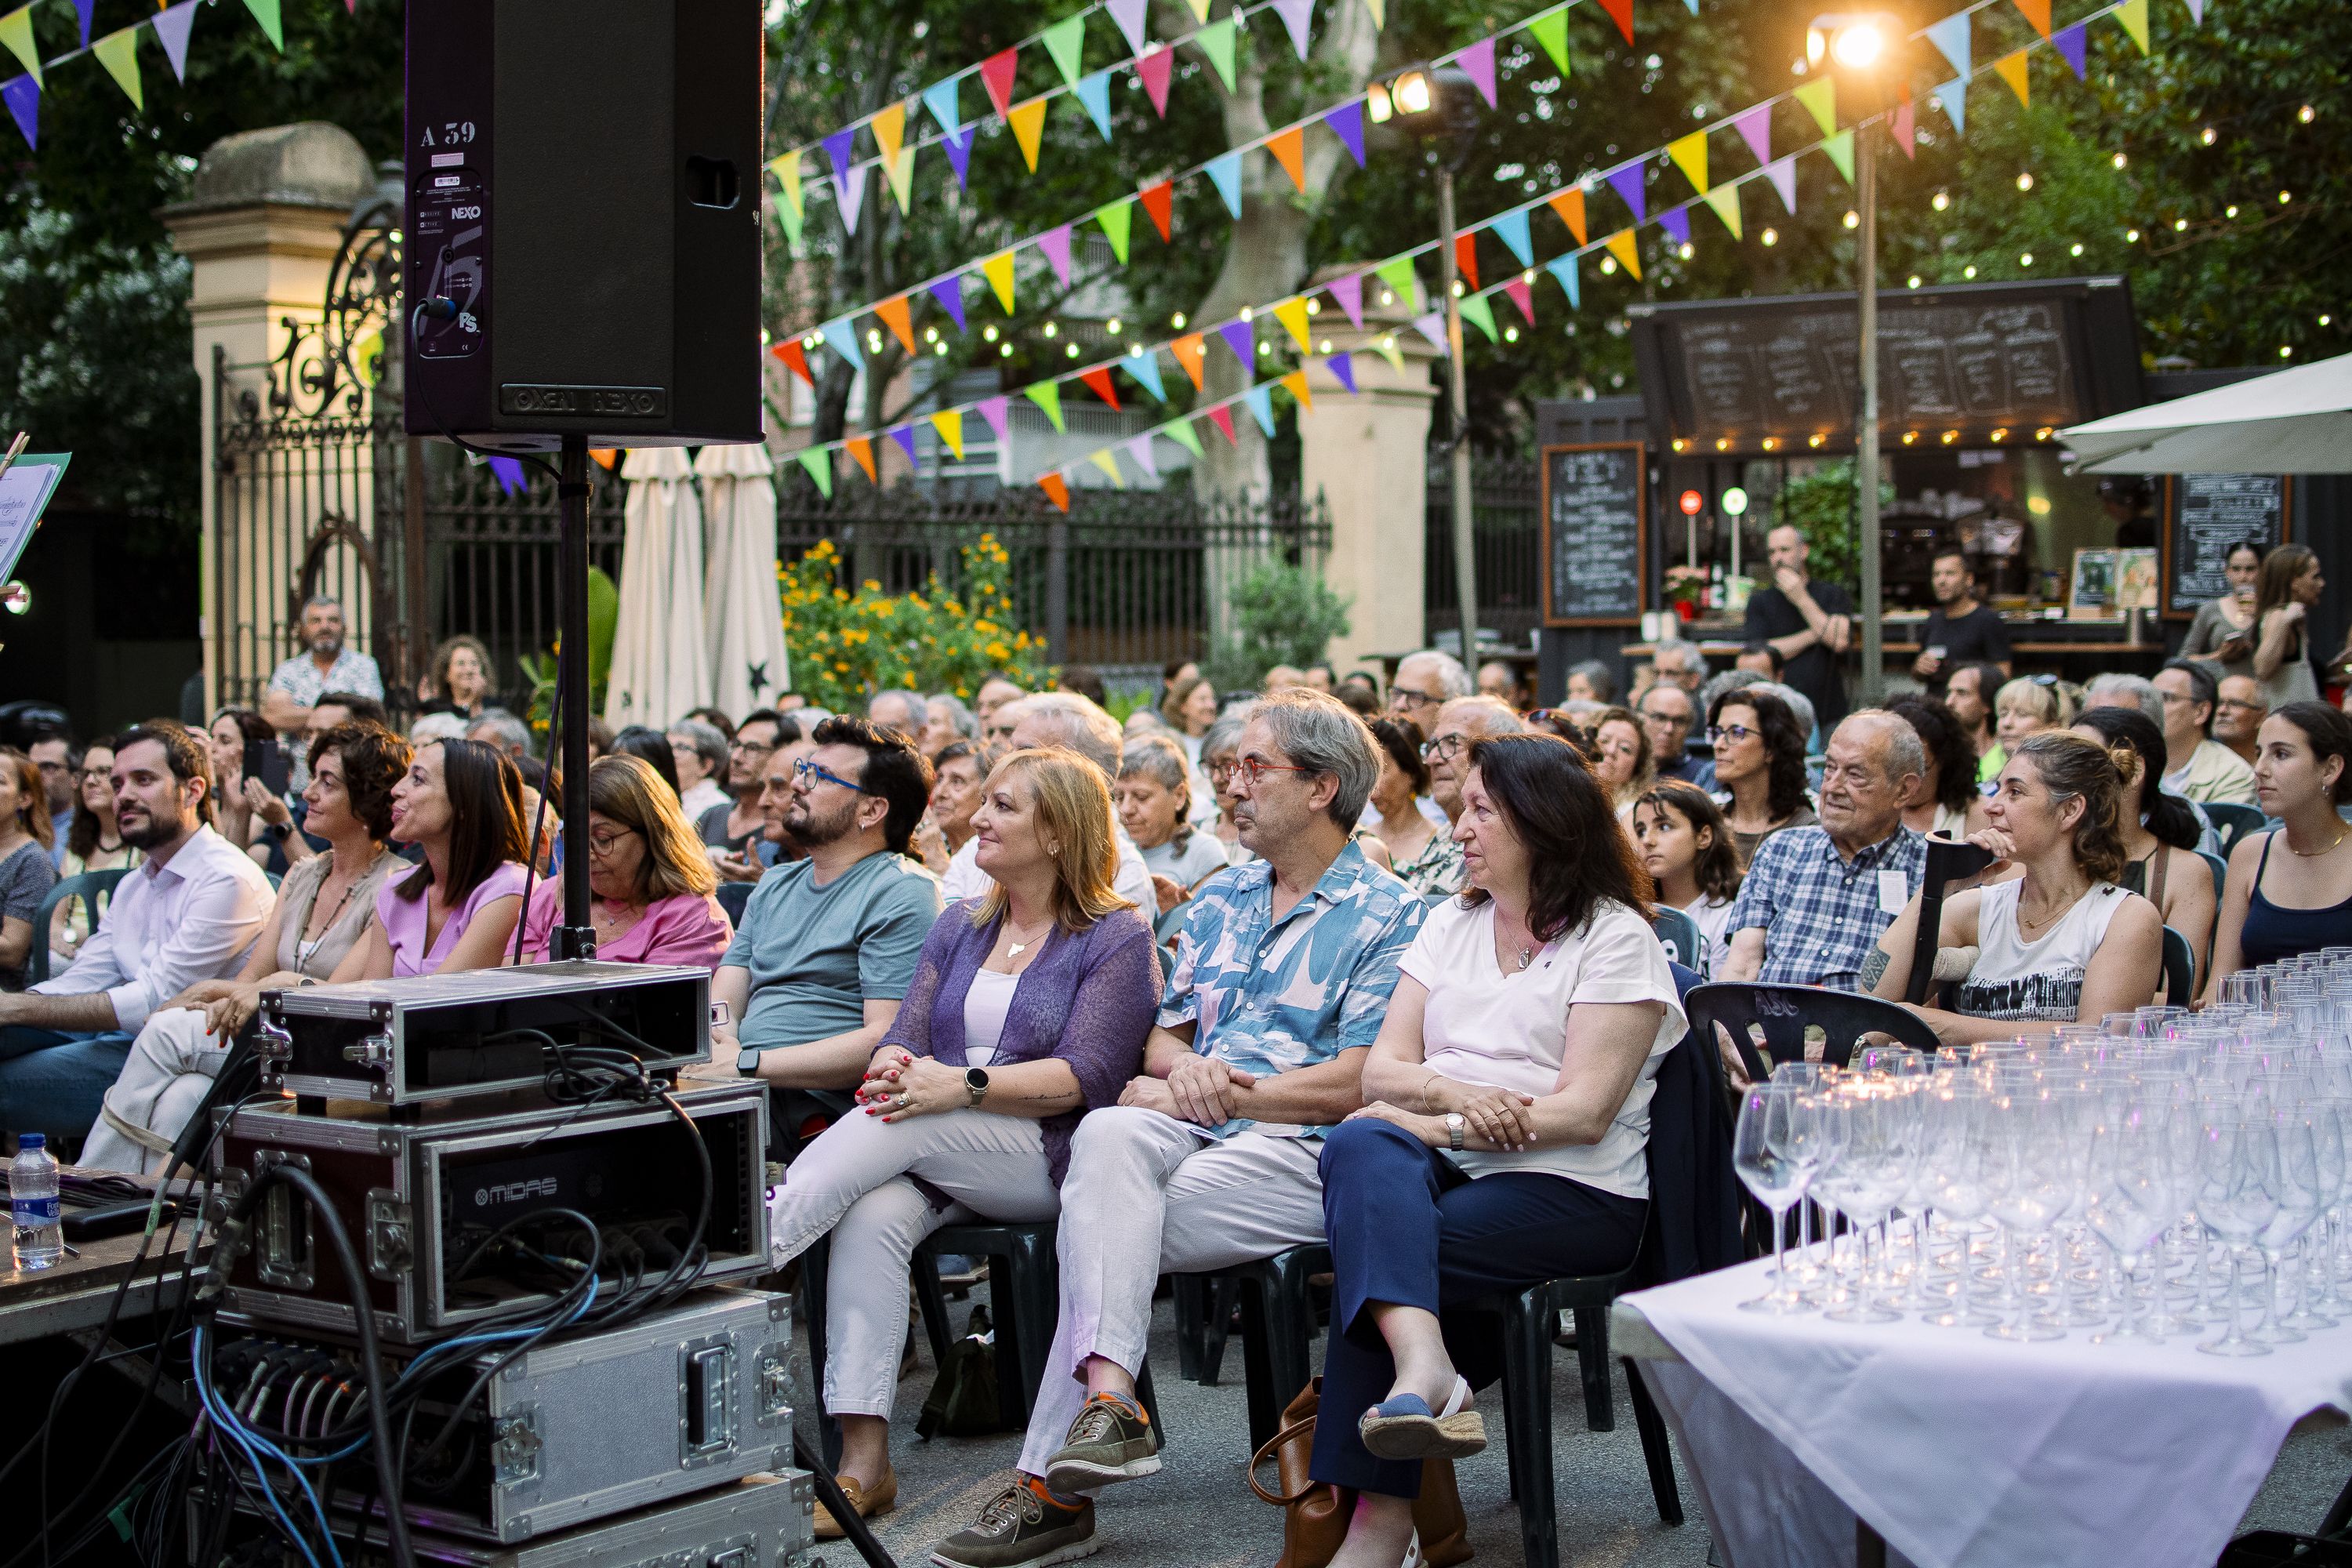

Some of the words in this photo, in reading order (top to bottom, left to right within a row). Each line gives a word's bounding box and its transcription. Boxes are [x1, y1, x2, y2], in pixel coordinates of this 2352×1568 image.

[420, 126, 436, 147] A
[452, 205, 481, 220] NEXO
[459, 312, 477, 333] PS
[489, 1177, 557, 1204] MIDAS
